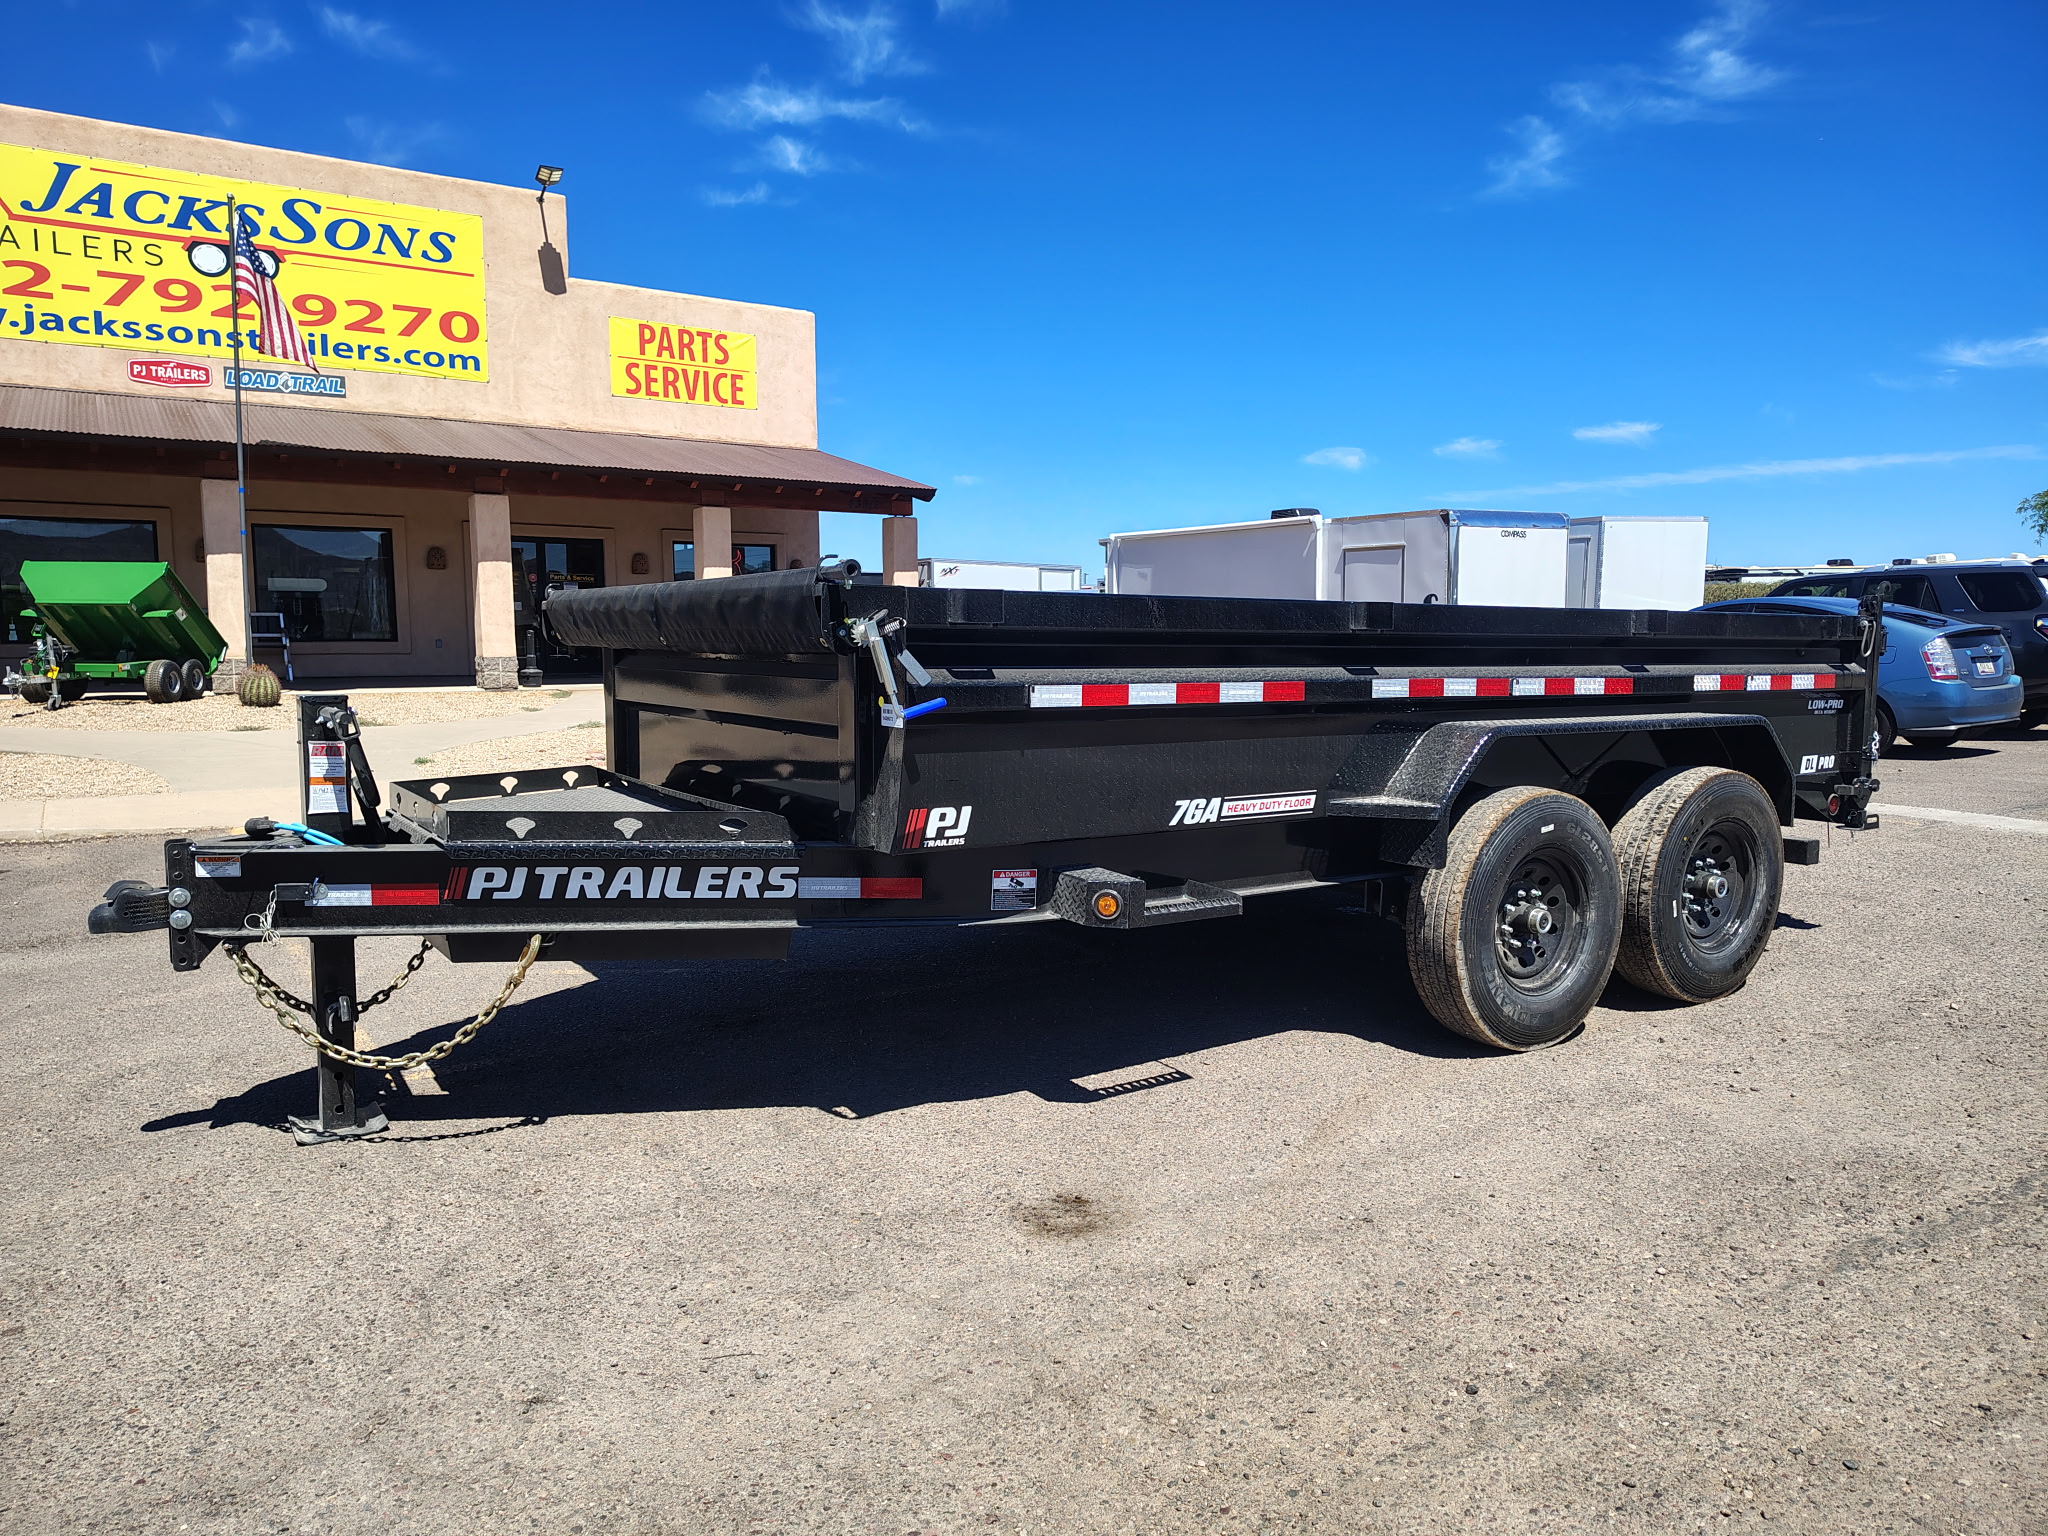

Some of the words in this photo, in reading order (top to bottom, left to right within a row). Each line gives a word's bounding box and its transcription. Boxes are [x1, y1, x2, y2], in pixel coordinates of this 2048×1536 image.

[2, 259, 480, 343] 2-7929270
[638, 323, 730, 365] PARTS
[133, 364, 146, 376] PJ
[149, 365, 207, 381] TRAILERS
[226, 369, 279, 389] LOAD
[290, 375, 345, 395] TRAIL
[625, 363, 745, 406] SERVICE
[1501, 530, 1527, 538] COMPASS
[1808, 699, 1844, 710] LOW-PRO
[311, 746, 345, 756] RAM
[1818, 755, 1835, 769] PRO
[925, 805, 972, 838] PJ
[1168, 797, 1222, 826] 7GA
[1227, 802, 1256, 813] HEAVY
[1259, 800, 1281, 811] DUTY
[1284, 798, 1311, 808] FLOOR
[923, 838, 965, 847] TRAILERS
[466, 867, 528, 899] PJ
[535, 867, 799, 899] TRAILERS
